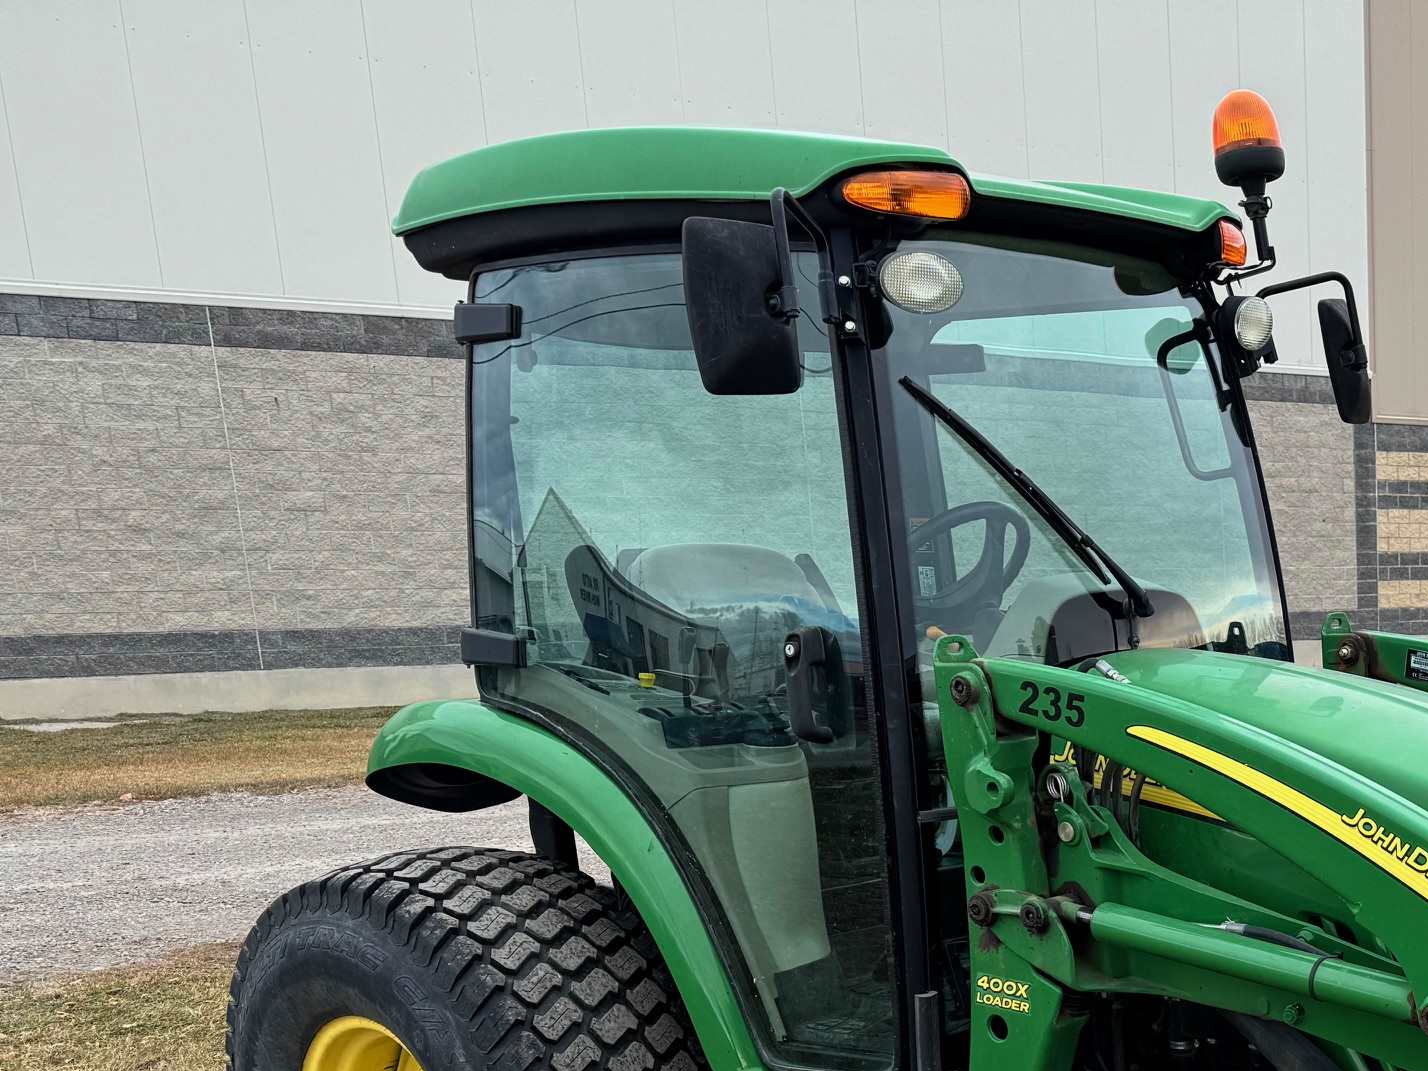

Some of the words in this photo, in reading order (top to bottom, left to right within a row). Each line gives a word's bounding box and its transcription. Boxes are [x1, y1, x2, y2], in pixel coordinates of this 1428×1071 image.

[1019, 681, 1085, 728] 235
[1054, 740, 1110, 773] JN
[1341, 808, 1411, 862] JOHN
[976, 992, 1030, 1013] LOADER
[977, 975, 1030, 998] 400X
